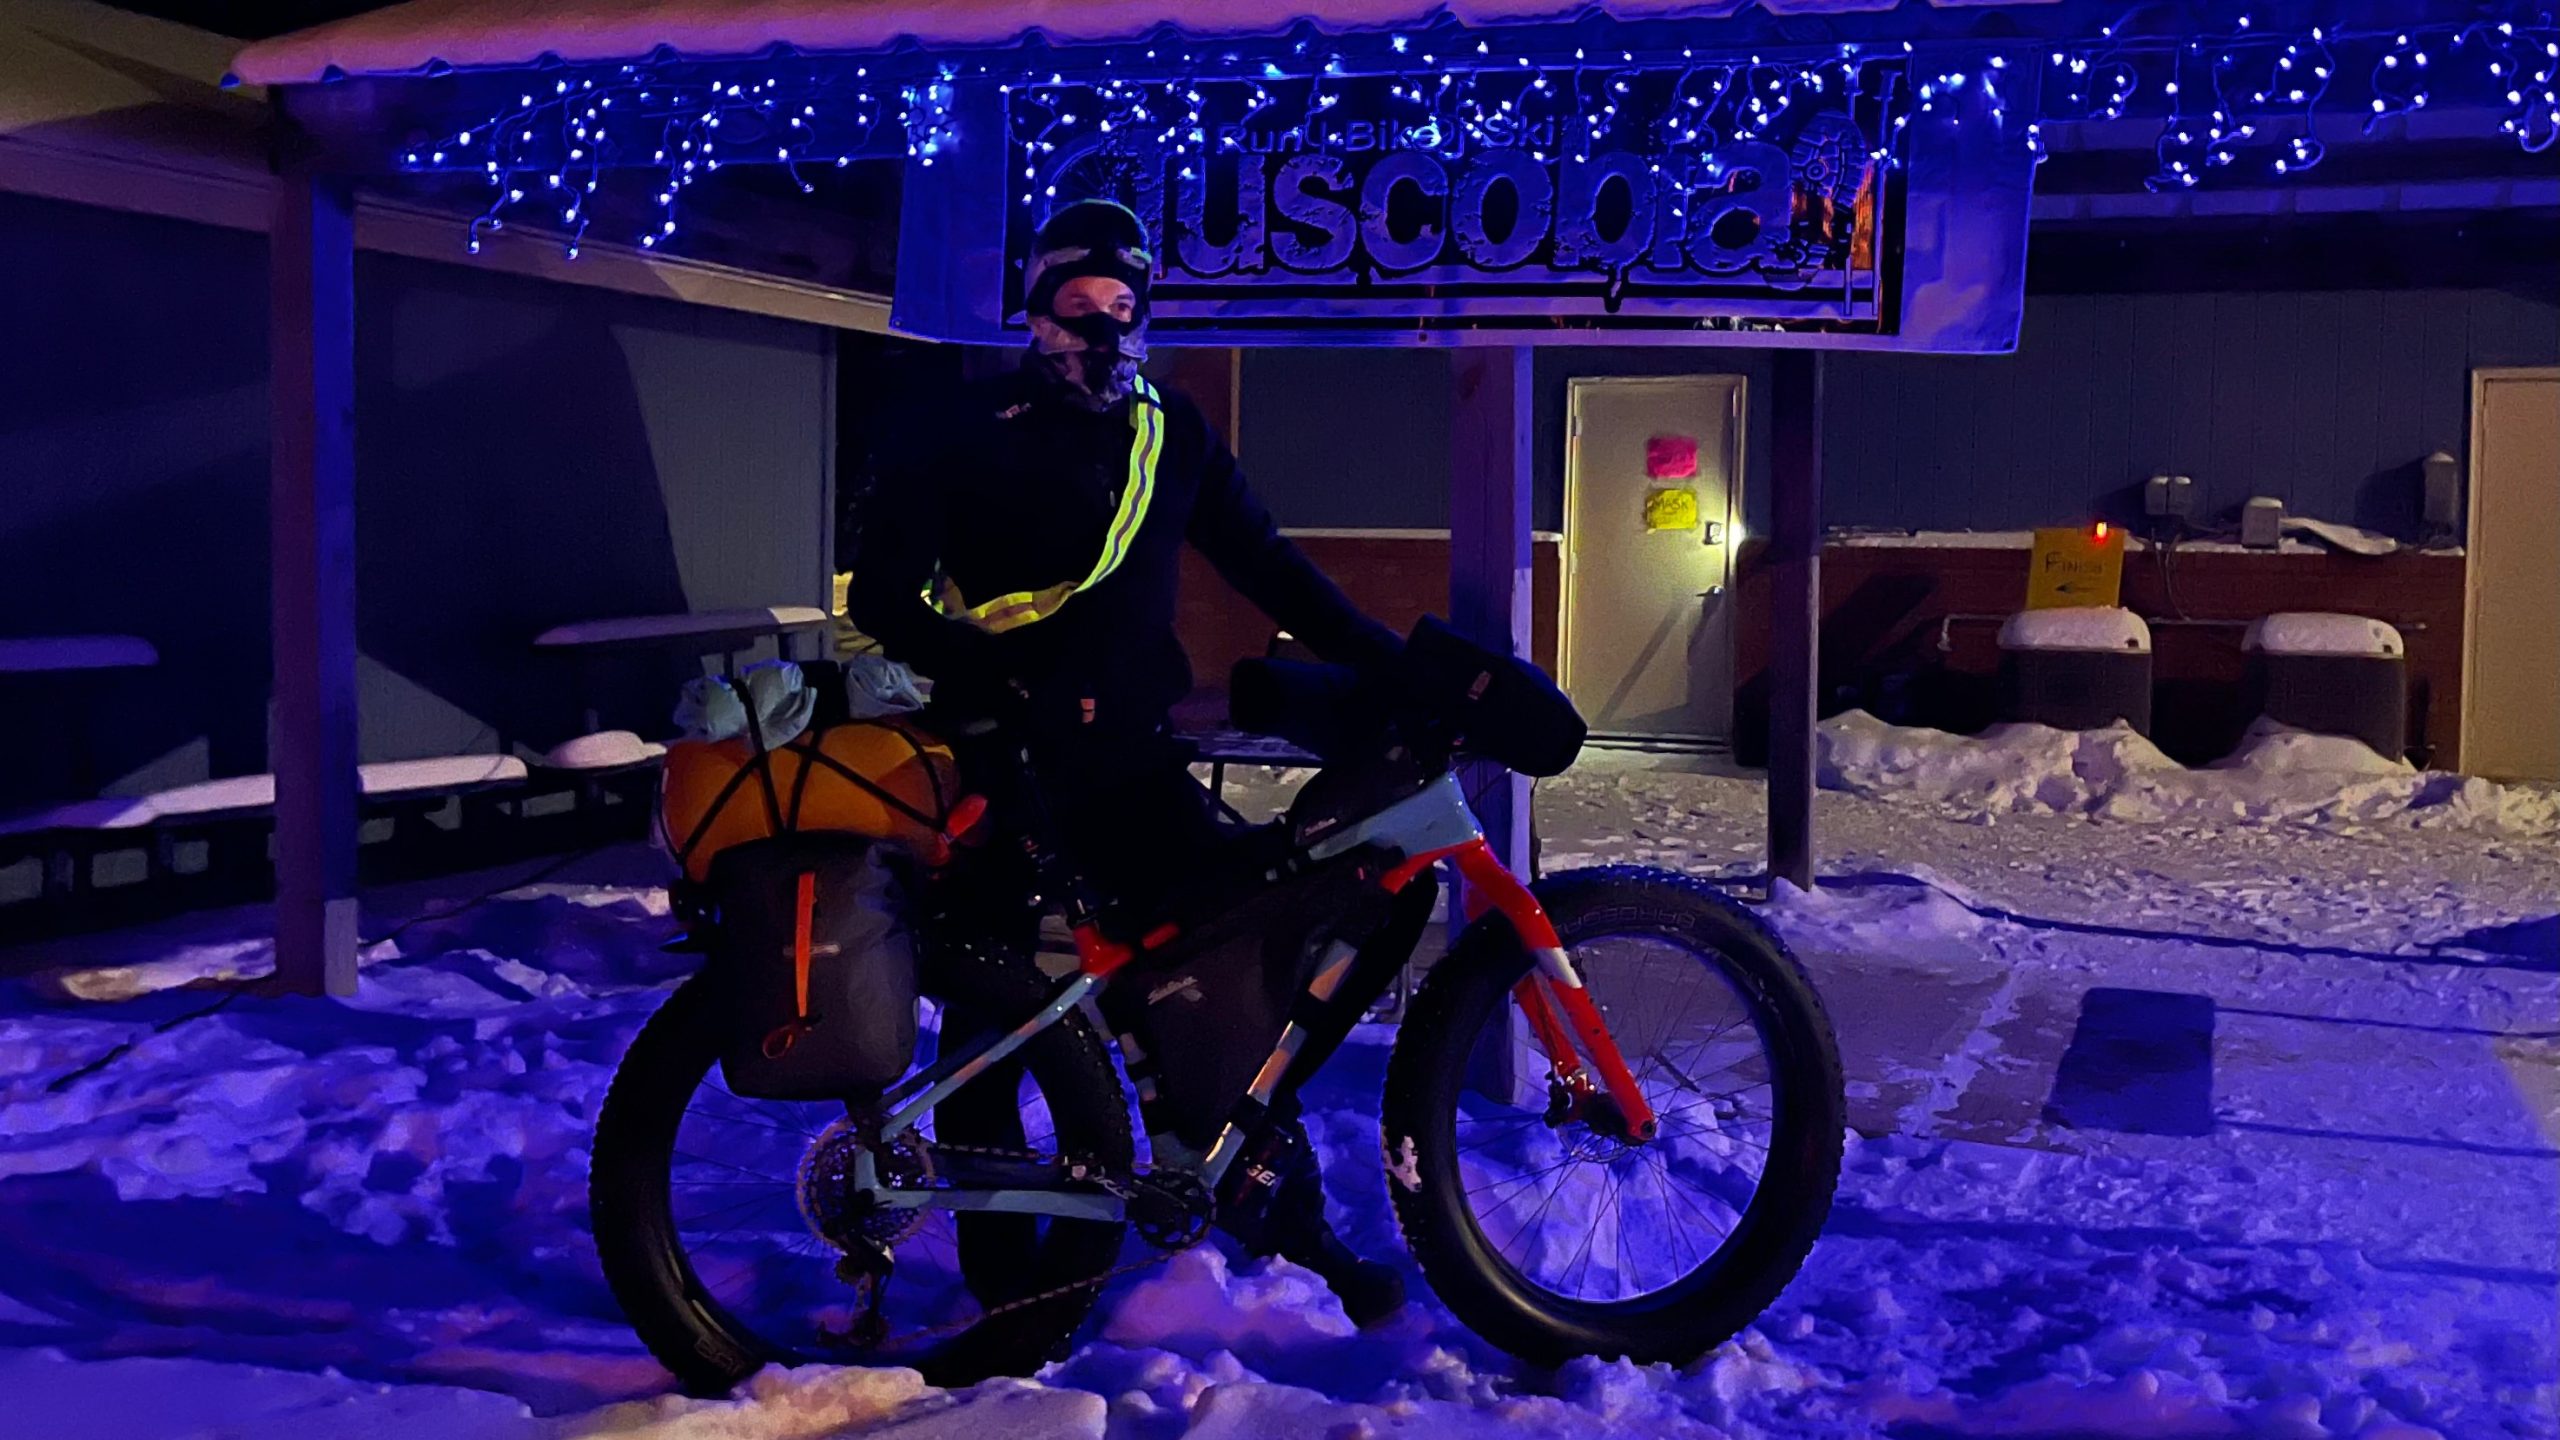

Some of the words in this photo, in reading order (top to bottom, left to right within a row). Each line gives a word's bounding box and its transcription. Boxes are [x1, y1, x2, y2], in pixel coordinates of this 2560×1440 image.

[1215, 123, 1304, 153] Run
[1345, 119, 1442, 151] Bike
[1479, 114, 1555, 148] Ski
